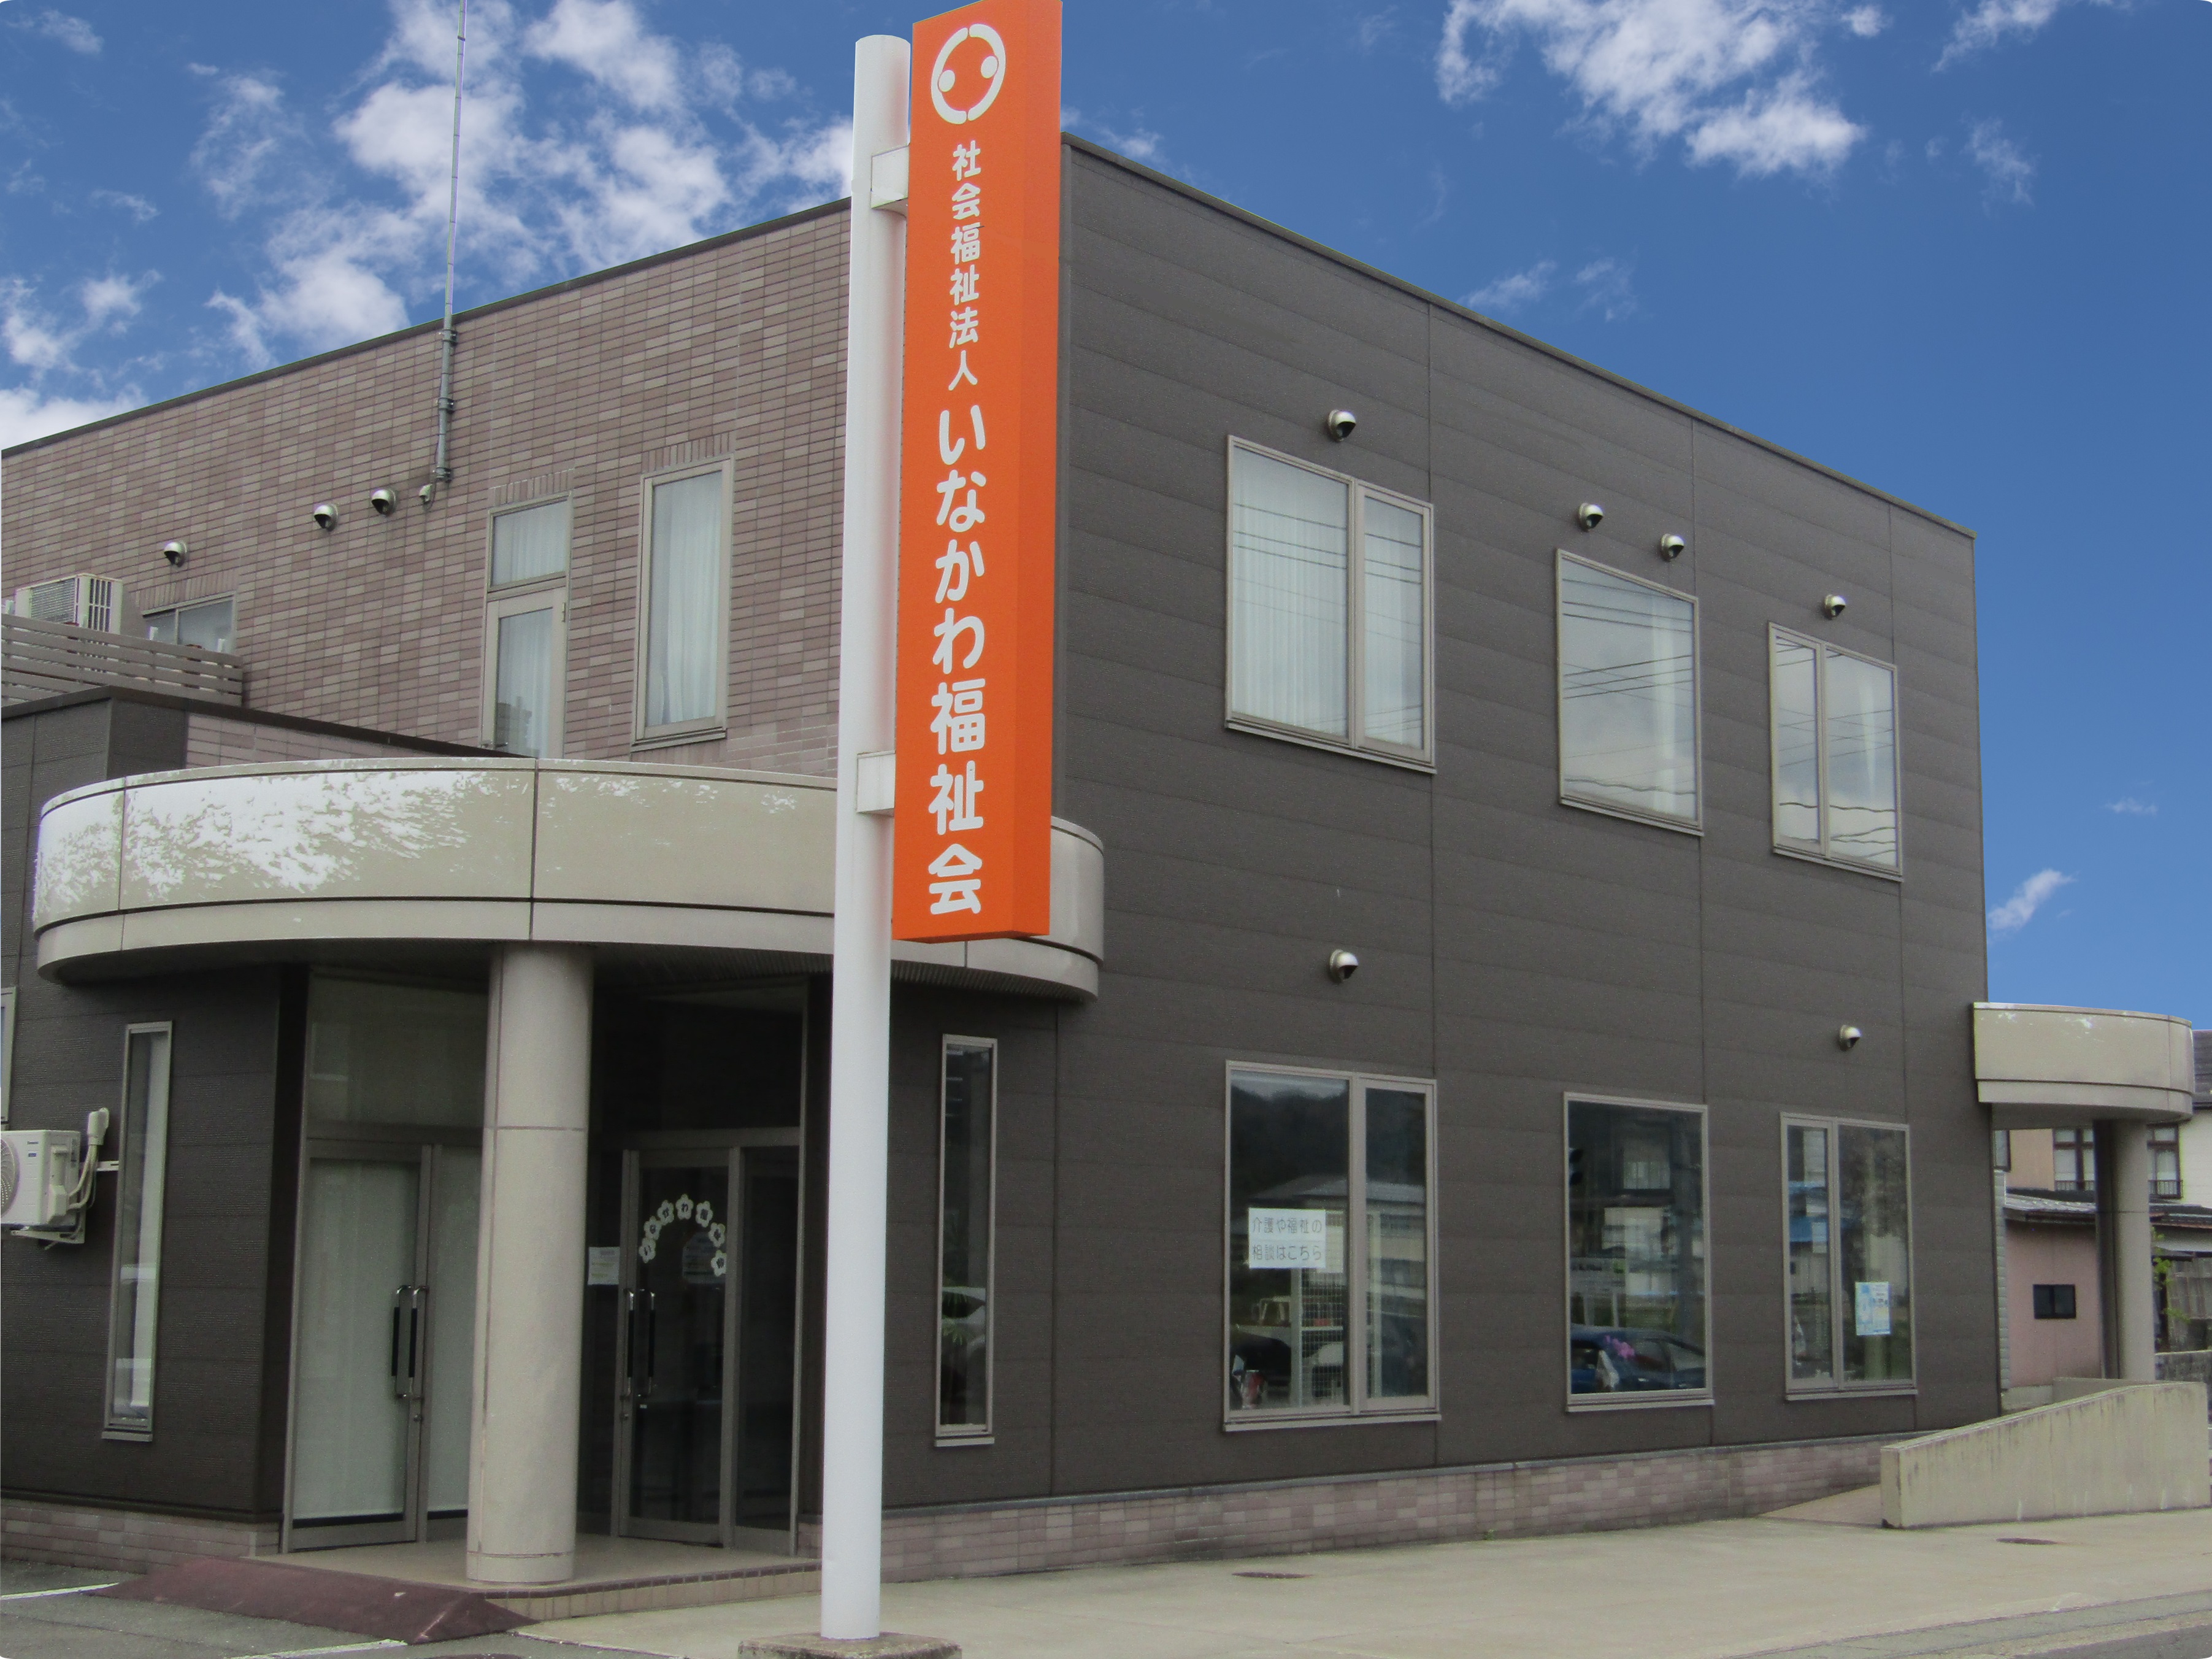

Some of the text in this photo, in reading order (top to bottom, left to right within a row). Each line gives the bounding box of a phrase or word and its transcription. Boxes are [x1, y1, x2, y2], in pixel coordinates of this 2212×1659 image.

[948, 139, 981, 390] 社会福祉法人
[928, 405, 986, 914] いなかわ福祉会
[1252, 1217, 1322, 1233] 介護や福祉の
[1252, 1245, 1322, 1261] 相談はこちら
